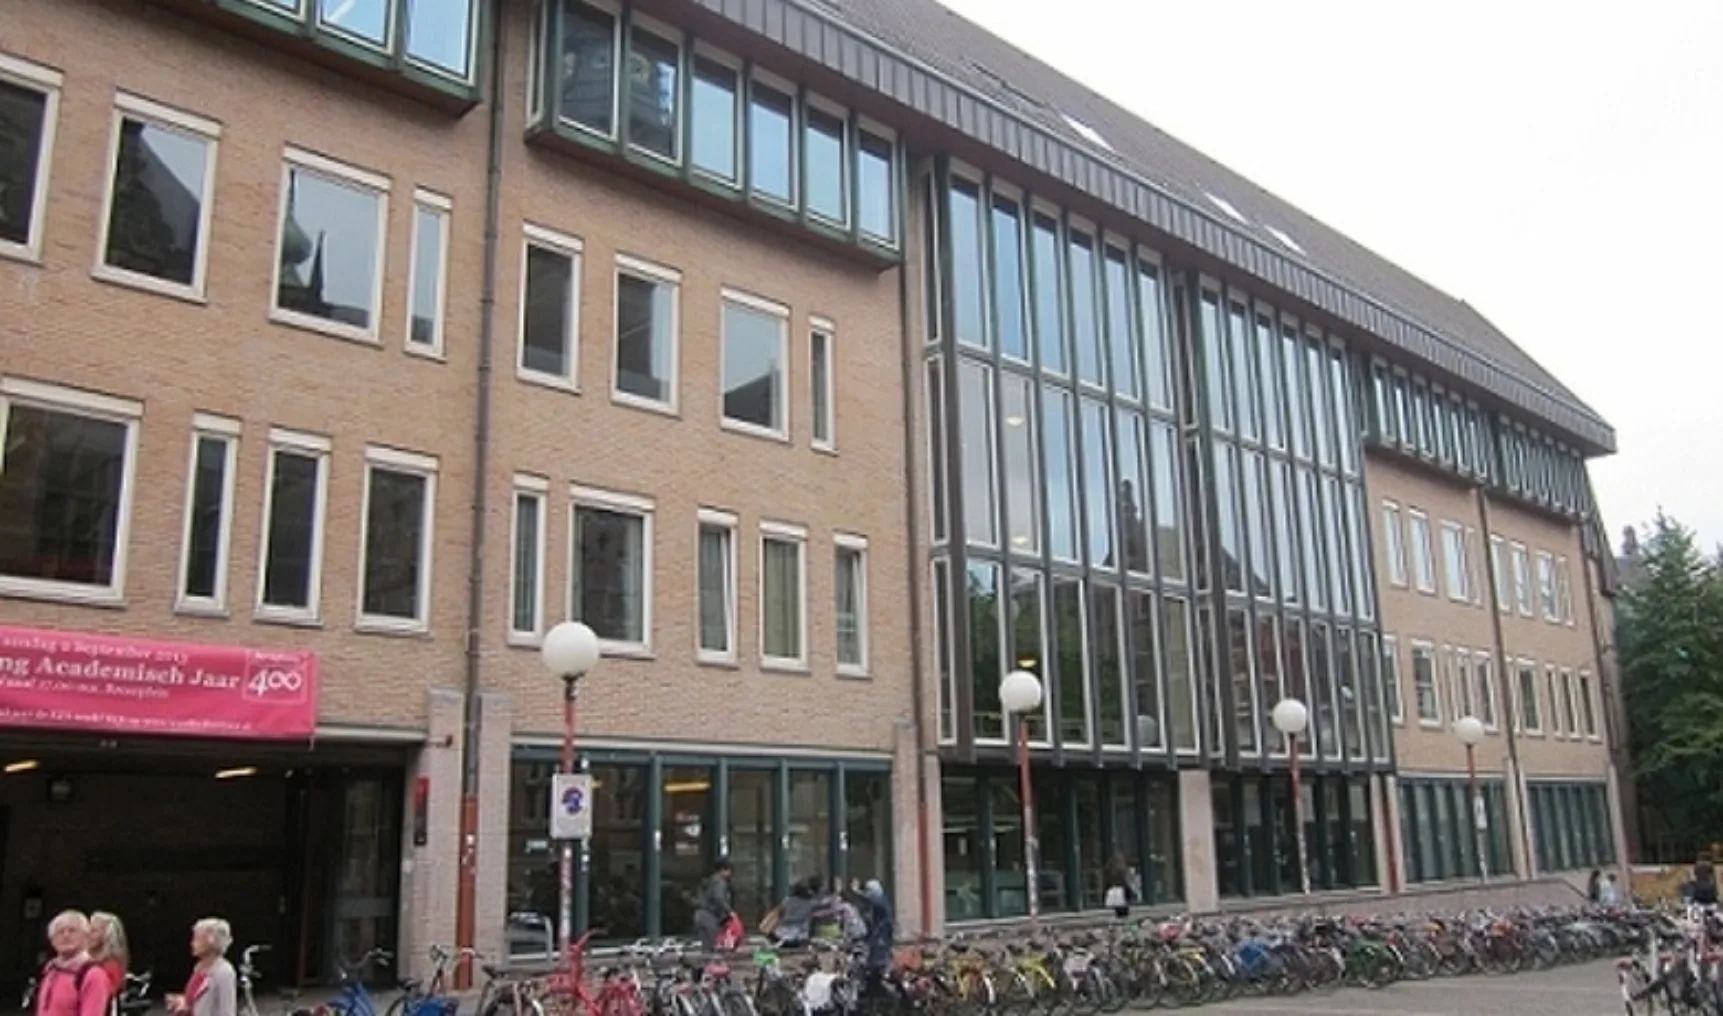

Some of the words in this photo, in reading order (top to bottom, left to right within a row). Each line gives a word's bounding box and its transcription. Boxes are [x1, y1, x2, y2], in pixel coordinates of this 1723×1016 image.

[34, 655, 185, 685] Academisch
[188, 667, 240, 689] Jaar
[247, 667, 302, 697] 400
